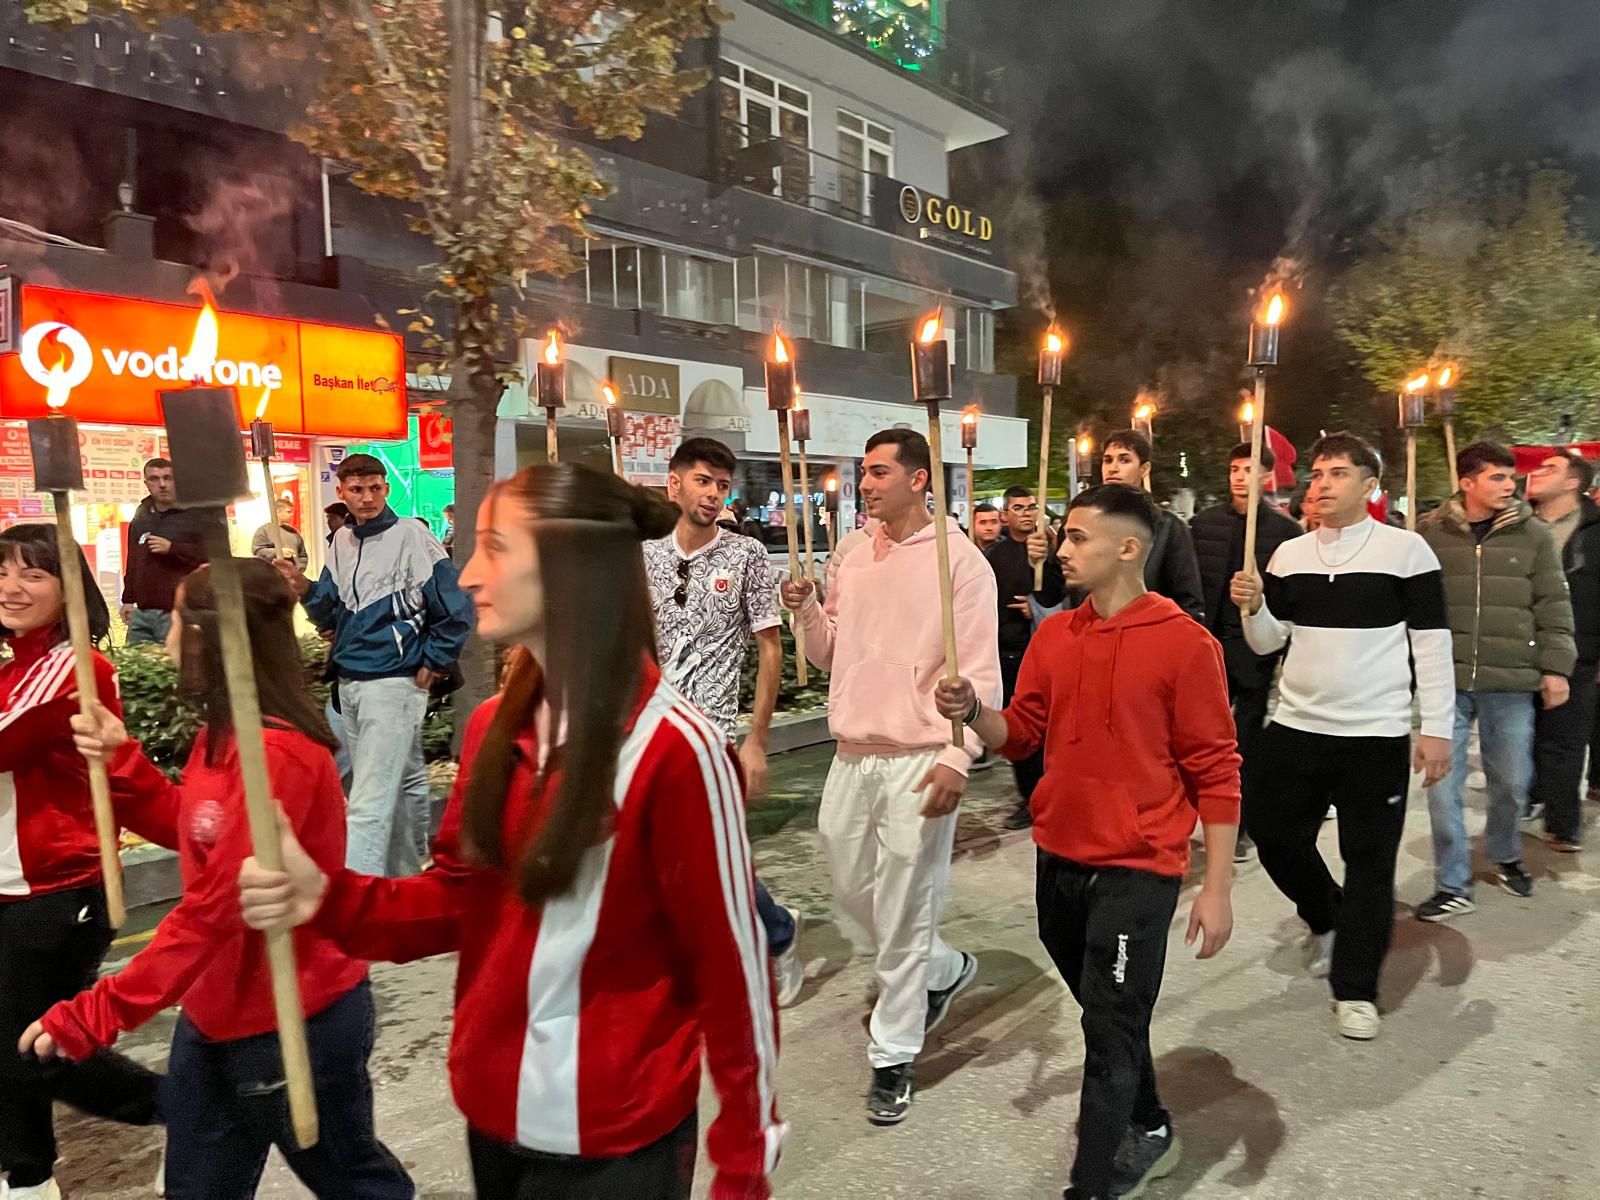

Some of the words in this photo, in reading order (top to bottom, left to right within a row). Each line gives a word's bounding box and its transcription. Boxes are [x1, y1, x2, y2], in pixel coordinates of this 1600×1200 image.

[926, 197, 993, 241] GOLD
[313, 373, 354, 391] Başkan
[622, 373, 672, 399] ADA
[577, 403, 607, 418] ADA
